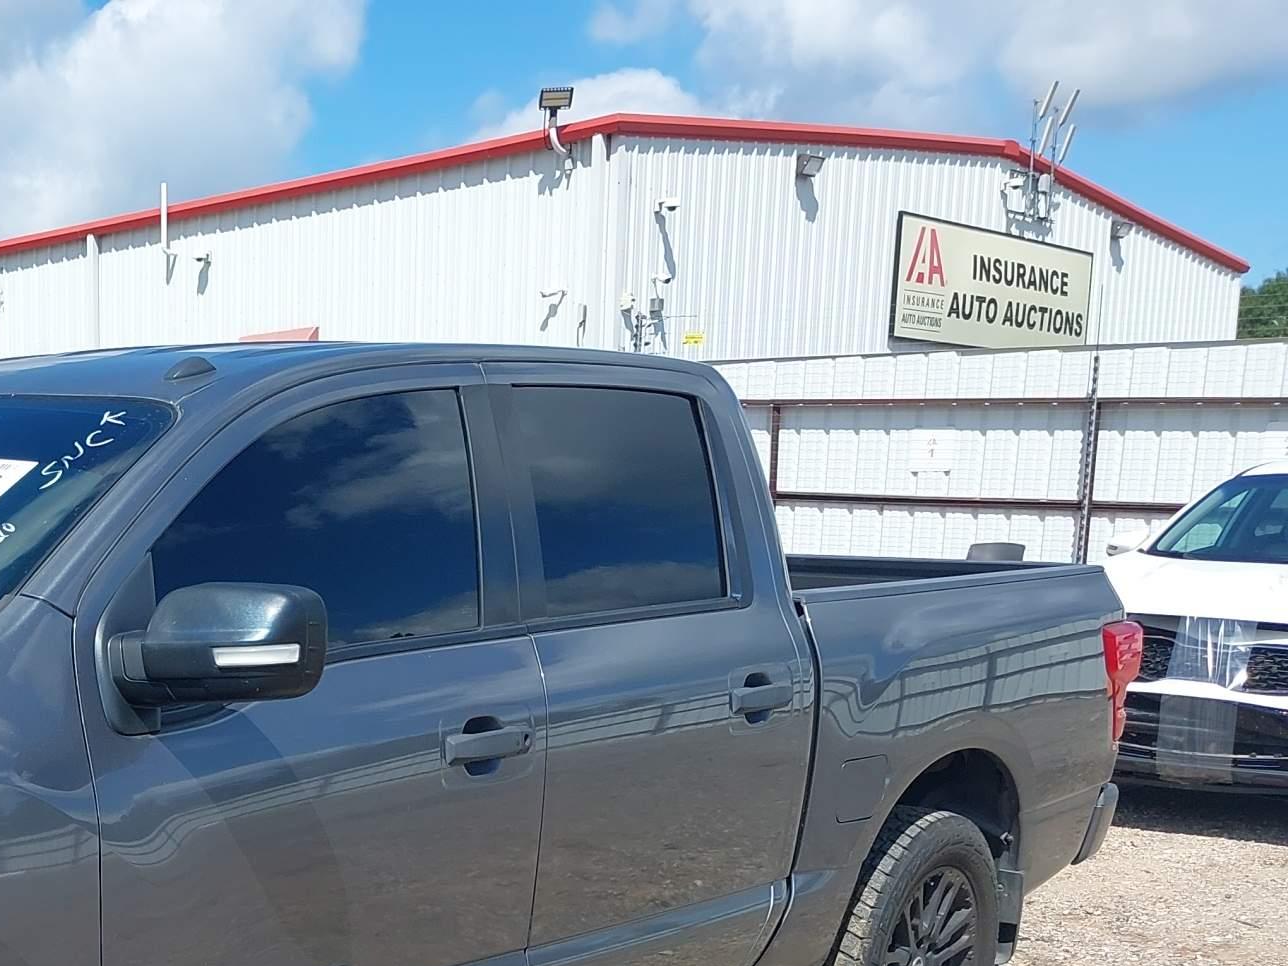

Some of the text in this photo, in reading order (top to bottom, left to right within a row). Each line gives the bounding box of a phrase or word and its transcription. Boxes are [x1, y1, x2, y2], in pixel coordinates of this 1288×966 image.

[972, 253, 1069, 297] INSURANCE
[903, 293, 944, 310] INSURANCE
[947, 291, 1083, 338] AUTO AUCTIONS
[901, 313, 942, 328] AUTO AUCTIONS
